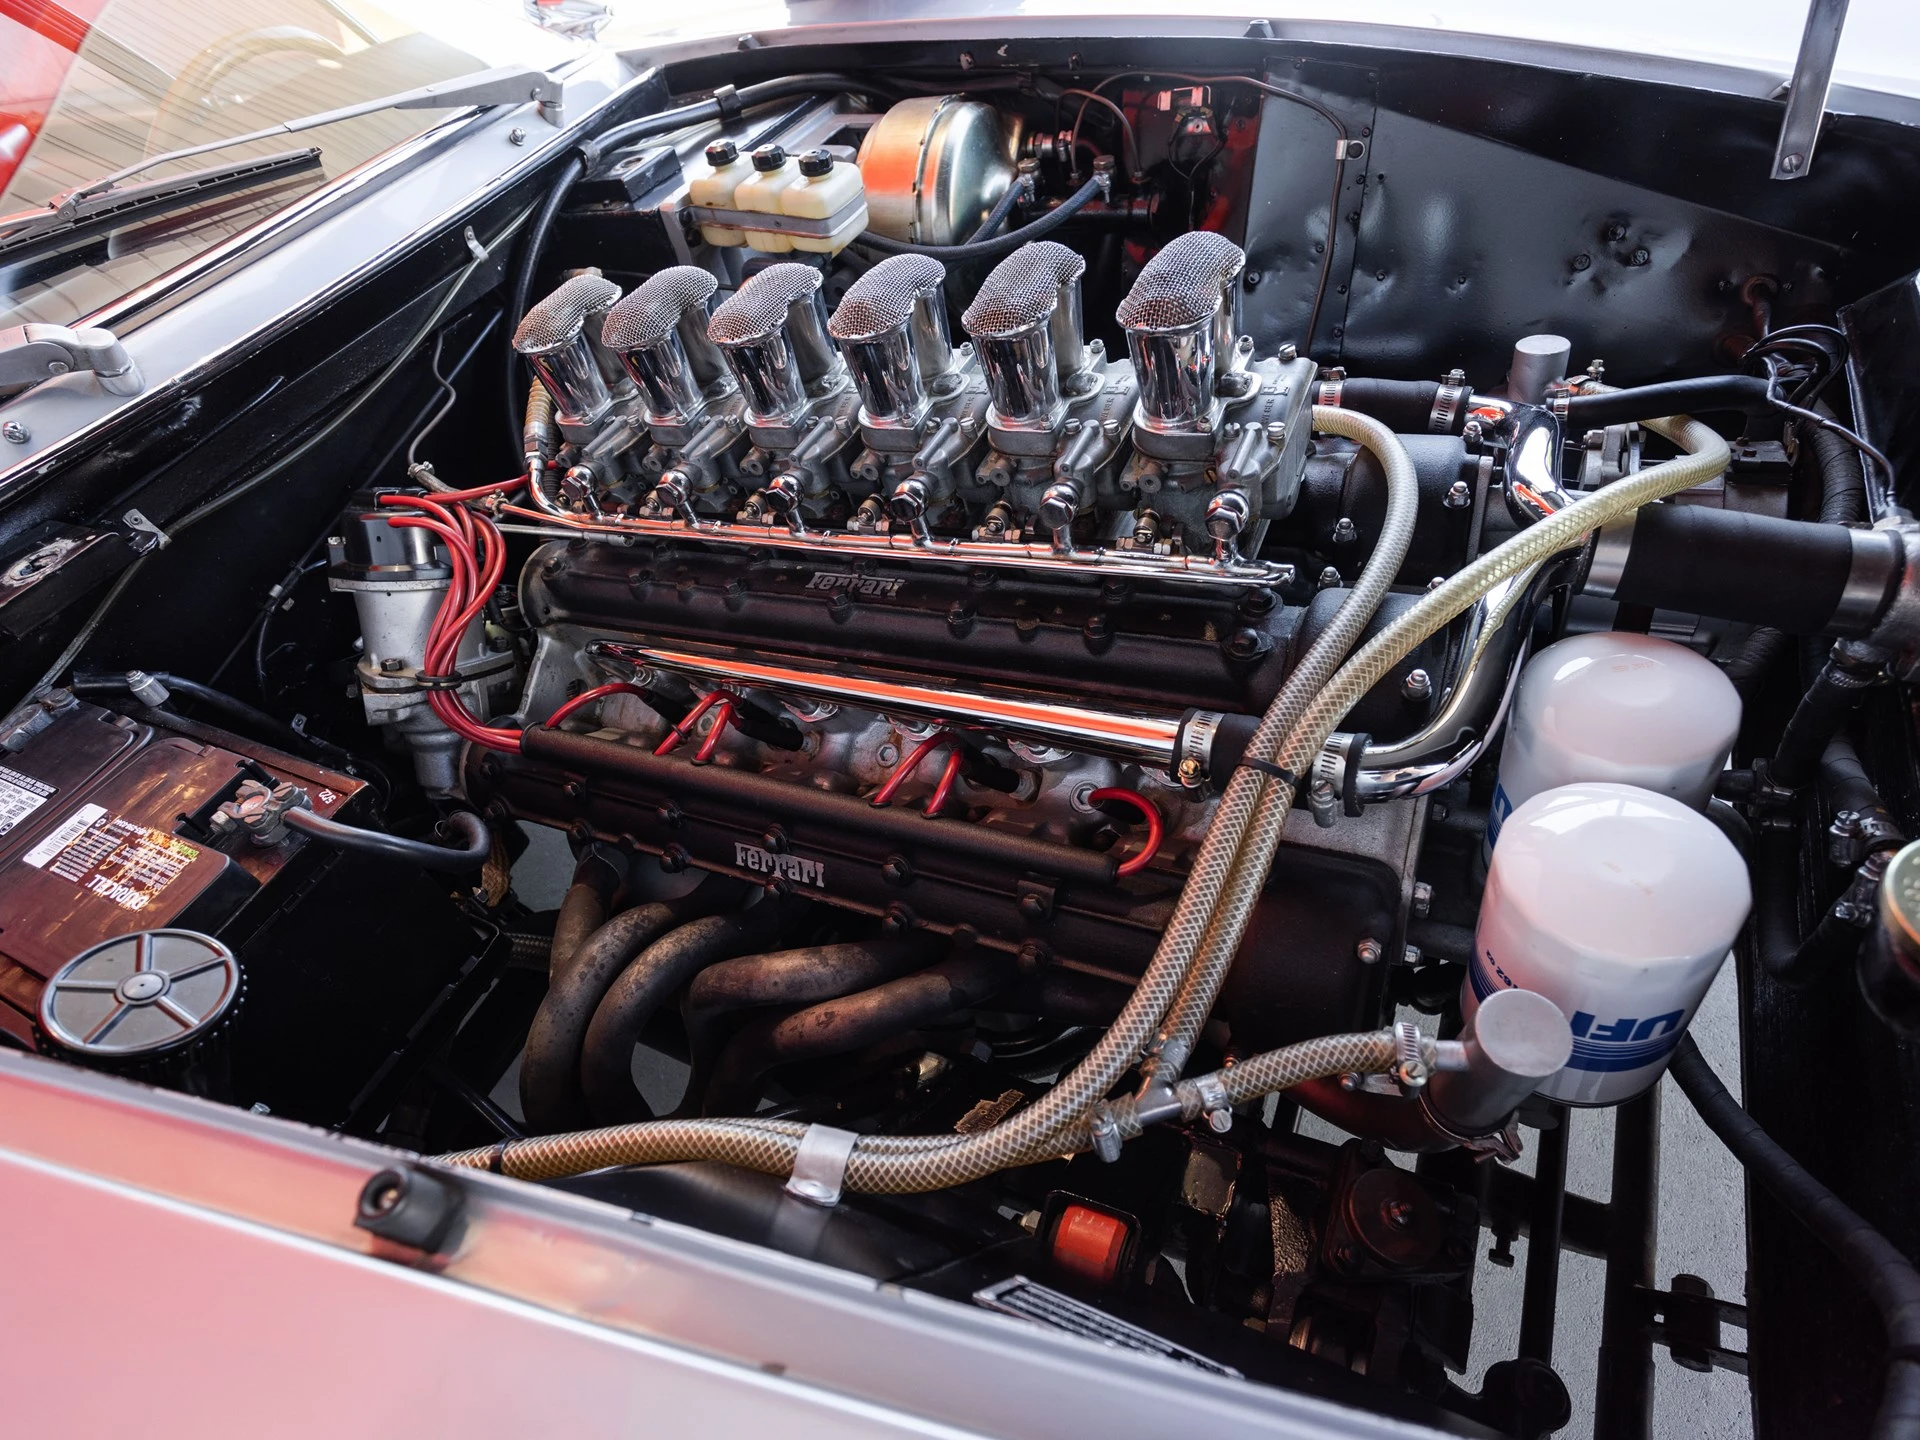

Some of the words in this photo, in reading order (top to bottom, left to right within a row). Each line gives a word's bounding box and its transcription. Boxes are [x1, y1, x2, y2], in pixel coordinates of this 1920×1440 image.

[1260, 398, 1275, 427] WEBER
[805, 571, 906, 597] Ferrari
[734, 842, 825, 888] Ferrari
[90, 873, 151, 911] DURACELL
[1569, 1008, 1686, 1043] UFI
